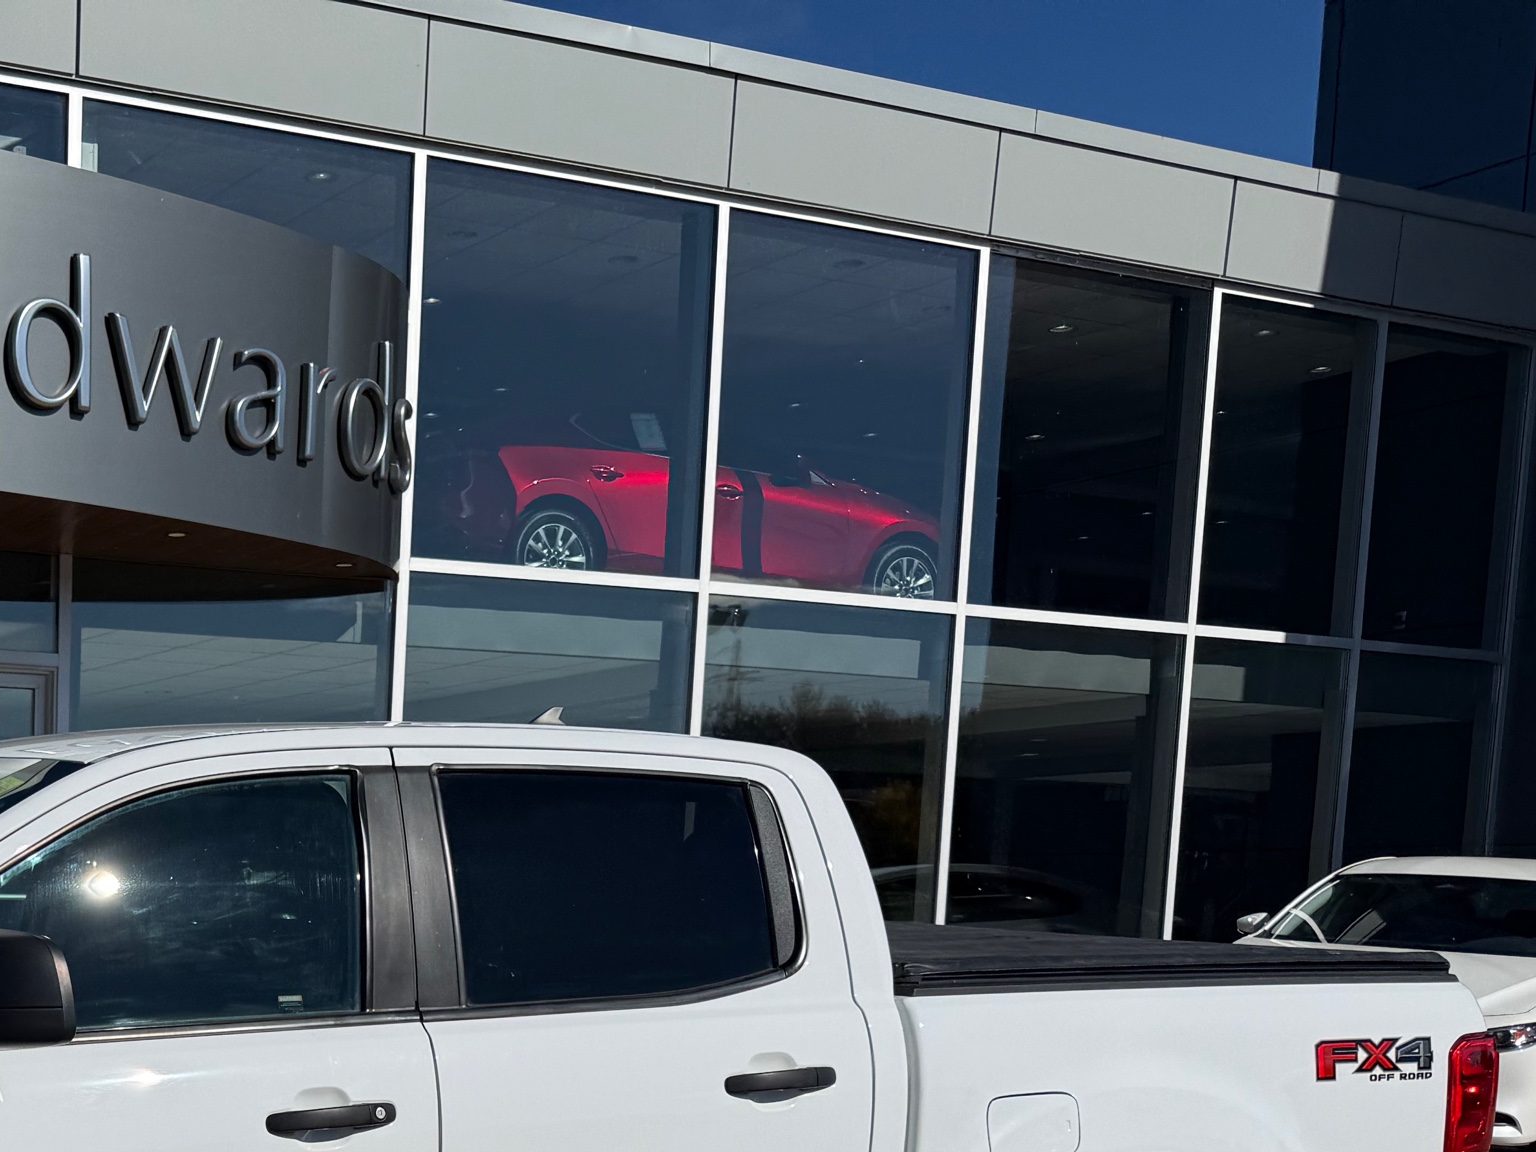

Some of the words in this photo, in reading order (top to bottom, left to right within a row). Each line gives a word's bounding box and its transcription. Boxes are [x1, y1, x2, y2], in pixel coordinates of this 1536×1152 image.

[1315, 1037, 1433, 1081] FX4
[1369, 1073, 1395, 1082] OFF
[1399, 1072, 1433, 1081] ROAD
